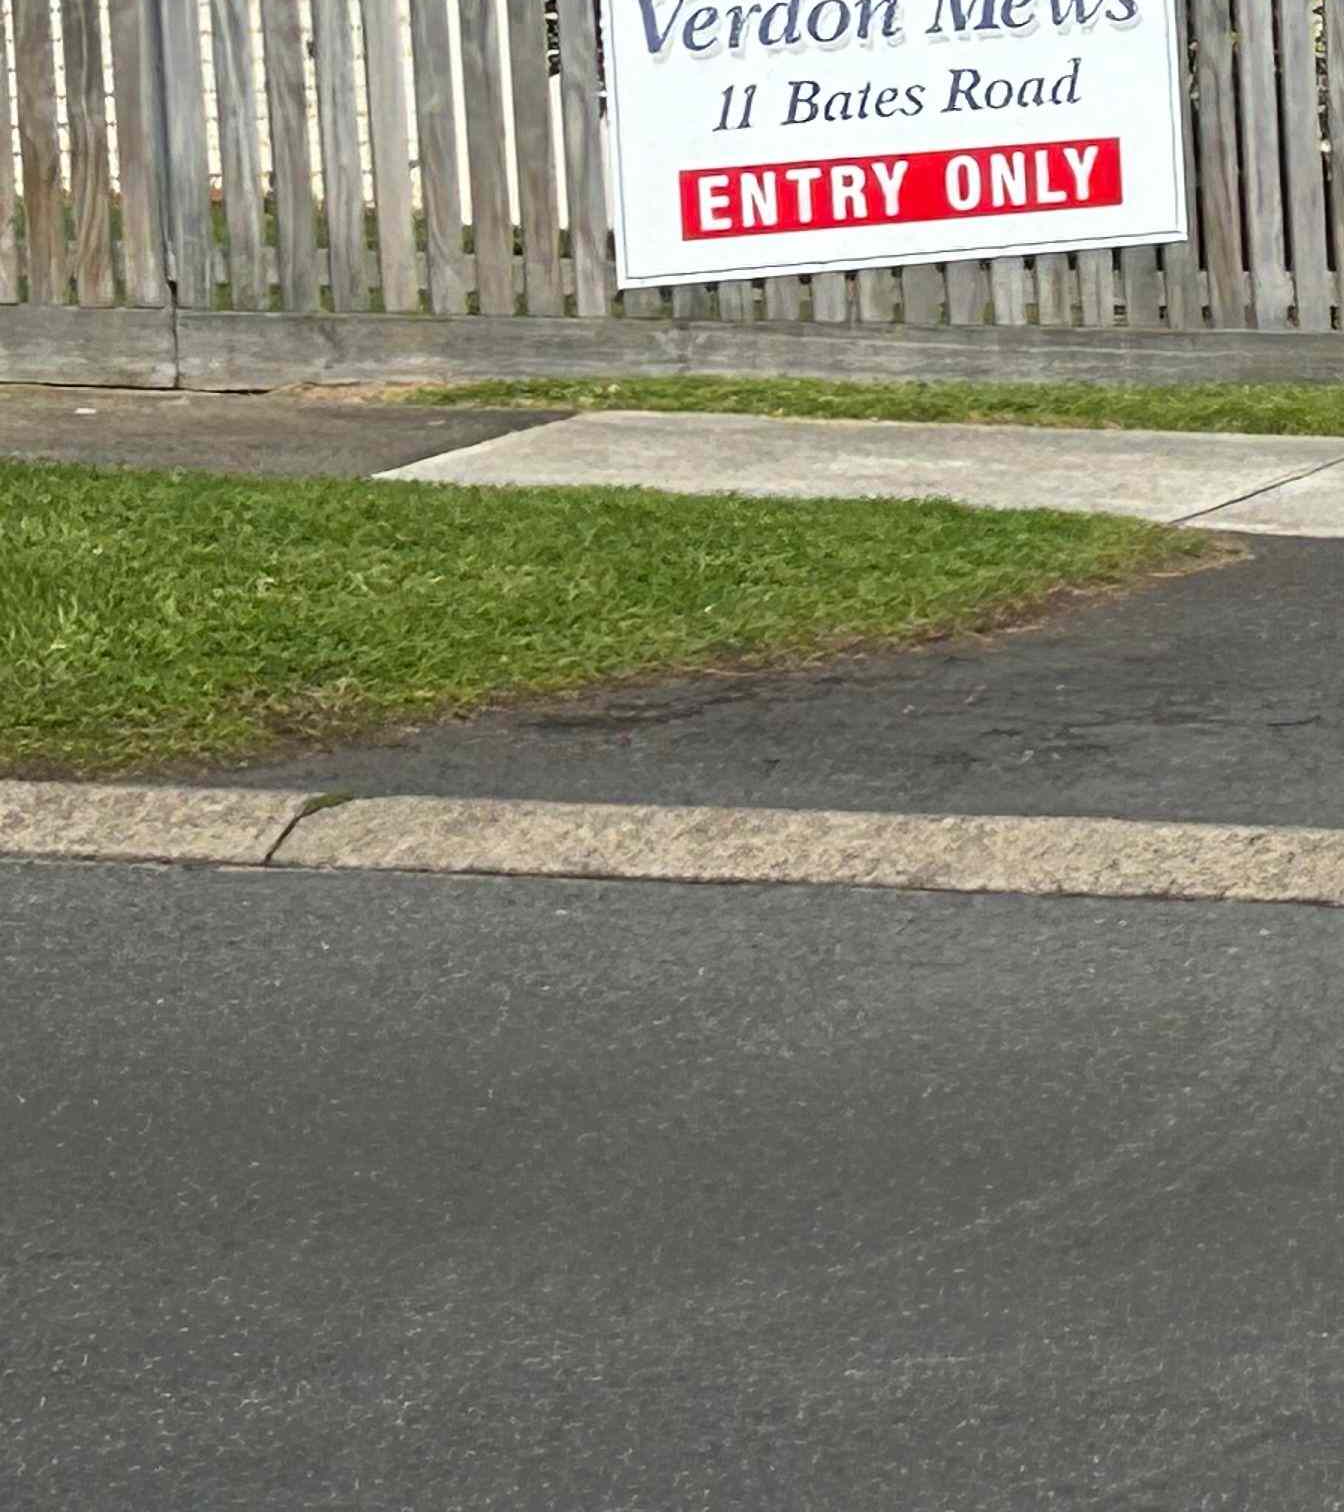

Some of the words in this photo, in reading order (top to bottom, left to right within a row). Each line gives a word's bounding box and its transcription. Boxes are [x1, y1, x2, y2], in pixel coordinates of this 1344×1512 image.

[712, 84, 757, 132] 11
[781, 79, 926, 126] Bates
[941, 57, 1082, 113] Road
[698, 159, 909, 231] ENTRY
[945, 145, 1099, 211] ONLY
